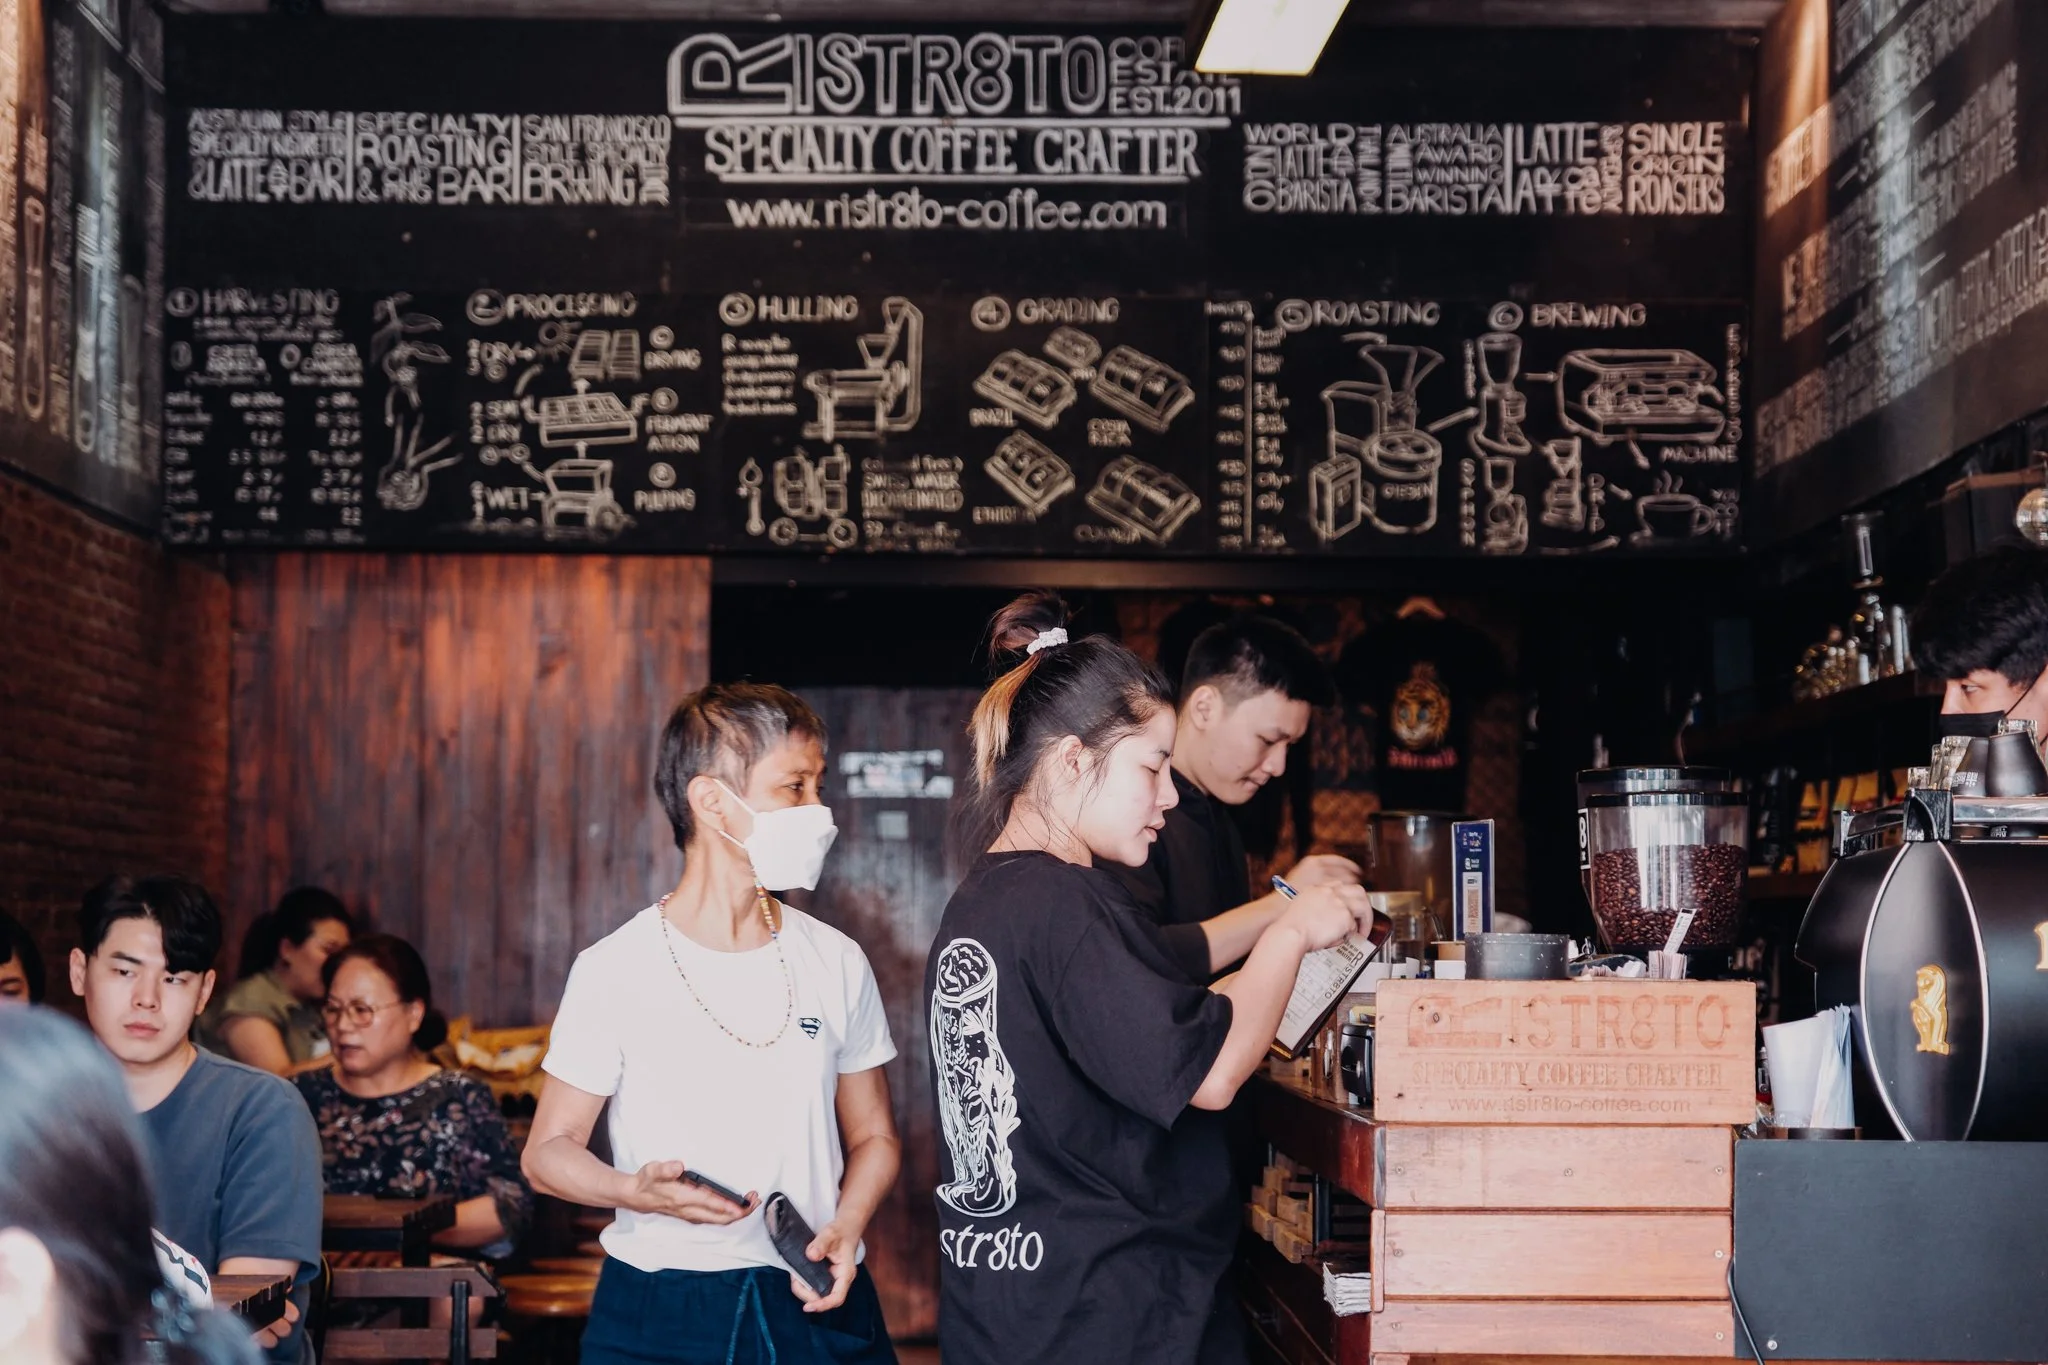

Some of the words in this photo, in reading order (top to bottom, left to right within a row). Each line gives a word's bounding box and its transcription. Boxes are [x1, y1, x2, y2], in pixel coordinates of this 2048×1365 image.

[1243, 122, 1355, 146] WORLD
[1514, 122, 1599, 166] LATTE
[1626, 122, 1725, 155] SINGLE
[355, 132, 512, 169] ROASTING
[704, 124, 879, 175] SPECIALTY
[890, 125, 1018, 175] COFFEE
[1033, 126, 1201, 177] CRAFTER
[1414, 142, 1504, 165] AWARD
[1626, 153, 1725, 176] ORIGIN
[436, 166, 512, 205] BAR
[1413, 163, 1505, 186] WINNING
[725, 186, 1168, 230] www.ristr8to-coffee.com
[1275, 177, 1357, 214] BARISTA
[1385, 183, 1507, 215] BARISTA
[1626, 173, 1725, 216] ROASTERS
[758, 295, 859, 322] HULLING
[1016, 297, 1120, 324] GRADING
[1311, 300, 1441, 327] ROASTING
[1530, 303, 1647, 328] BREWING
[1412, 1061, 1529, 1086] SPECIALTY
[1537, 1062, 1618, 1086] COFFEE
[1625, 1062, 1722, 1087] CRAFTER
